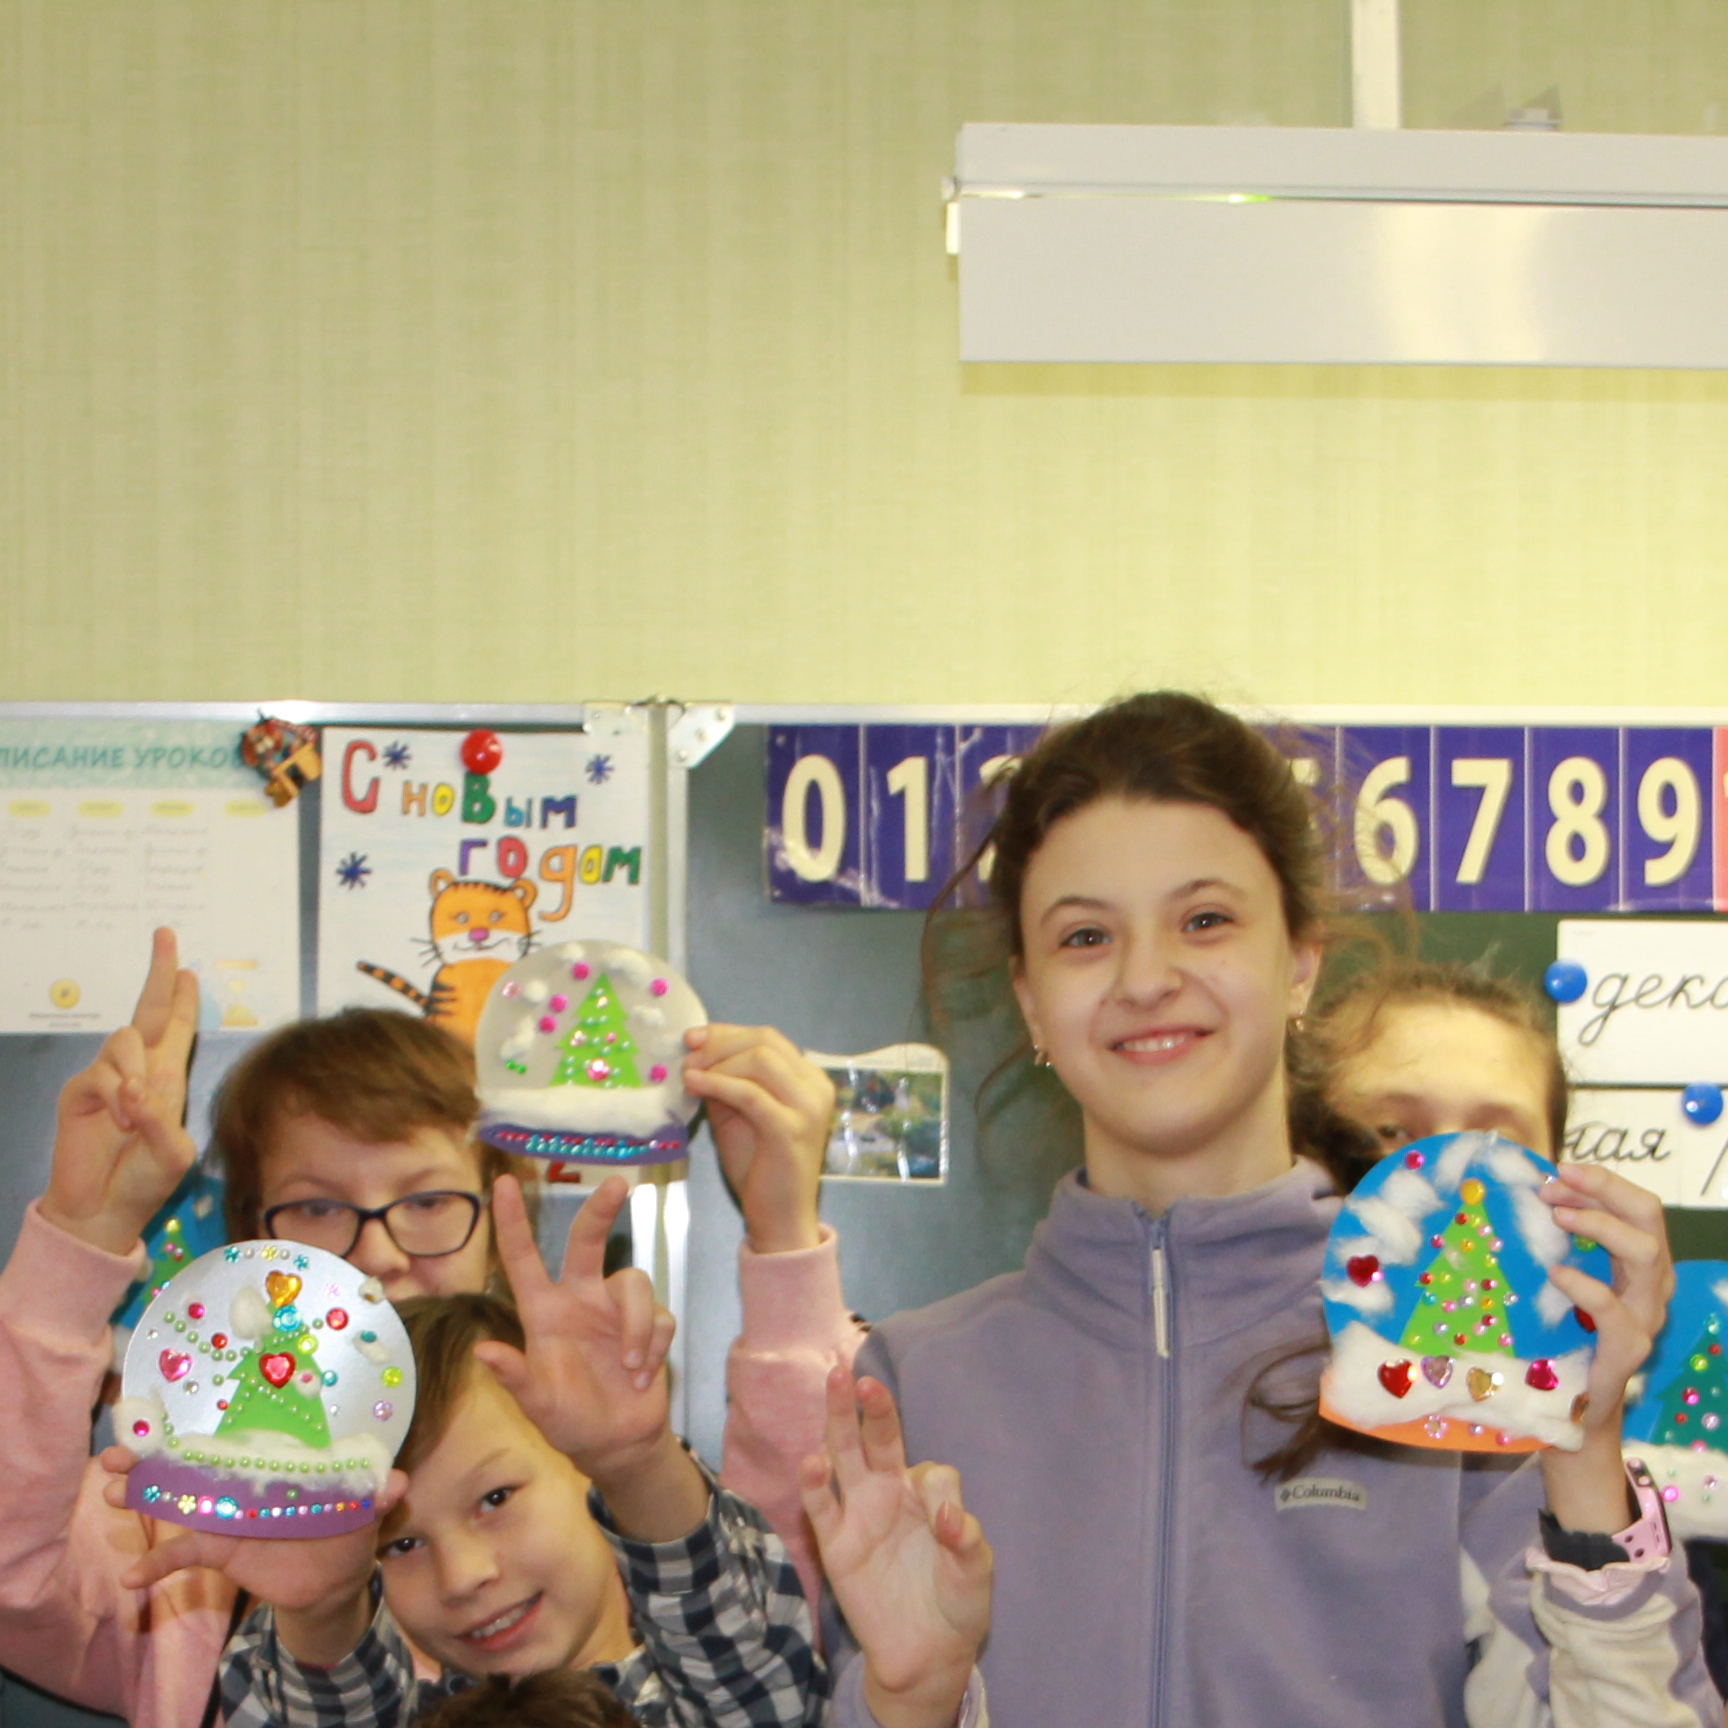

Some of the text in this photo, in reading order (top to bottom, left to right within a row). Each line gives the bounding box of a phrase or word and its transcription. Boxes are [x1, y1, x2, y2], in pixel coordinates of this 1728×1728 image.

[782, 754, 846, 882] 0
[886, 756, 930, 882] 1
[1354, 756, 1419, 886] 6
[1451, 758, 1511, 884] 7
[1546, 757, 1610, 886] 8
[1637, 757, 1701, 886] 9
[459, 836, 643, 922] годом
[1292, 1483, 1360, 1502] Columbia
